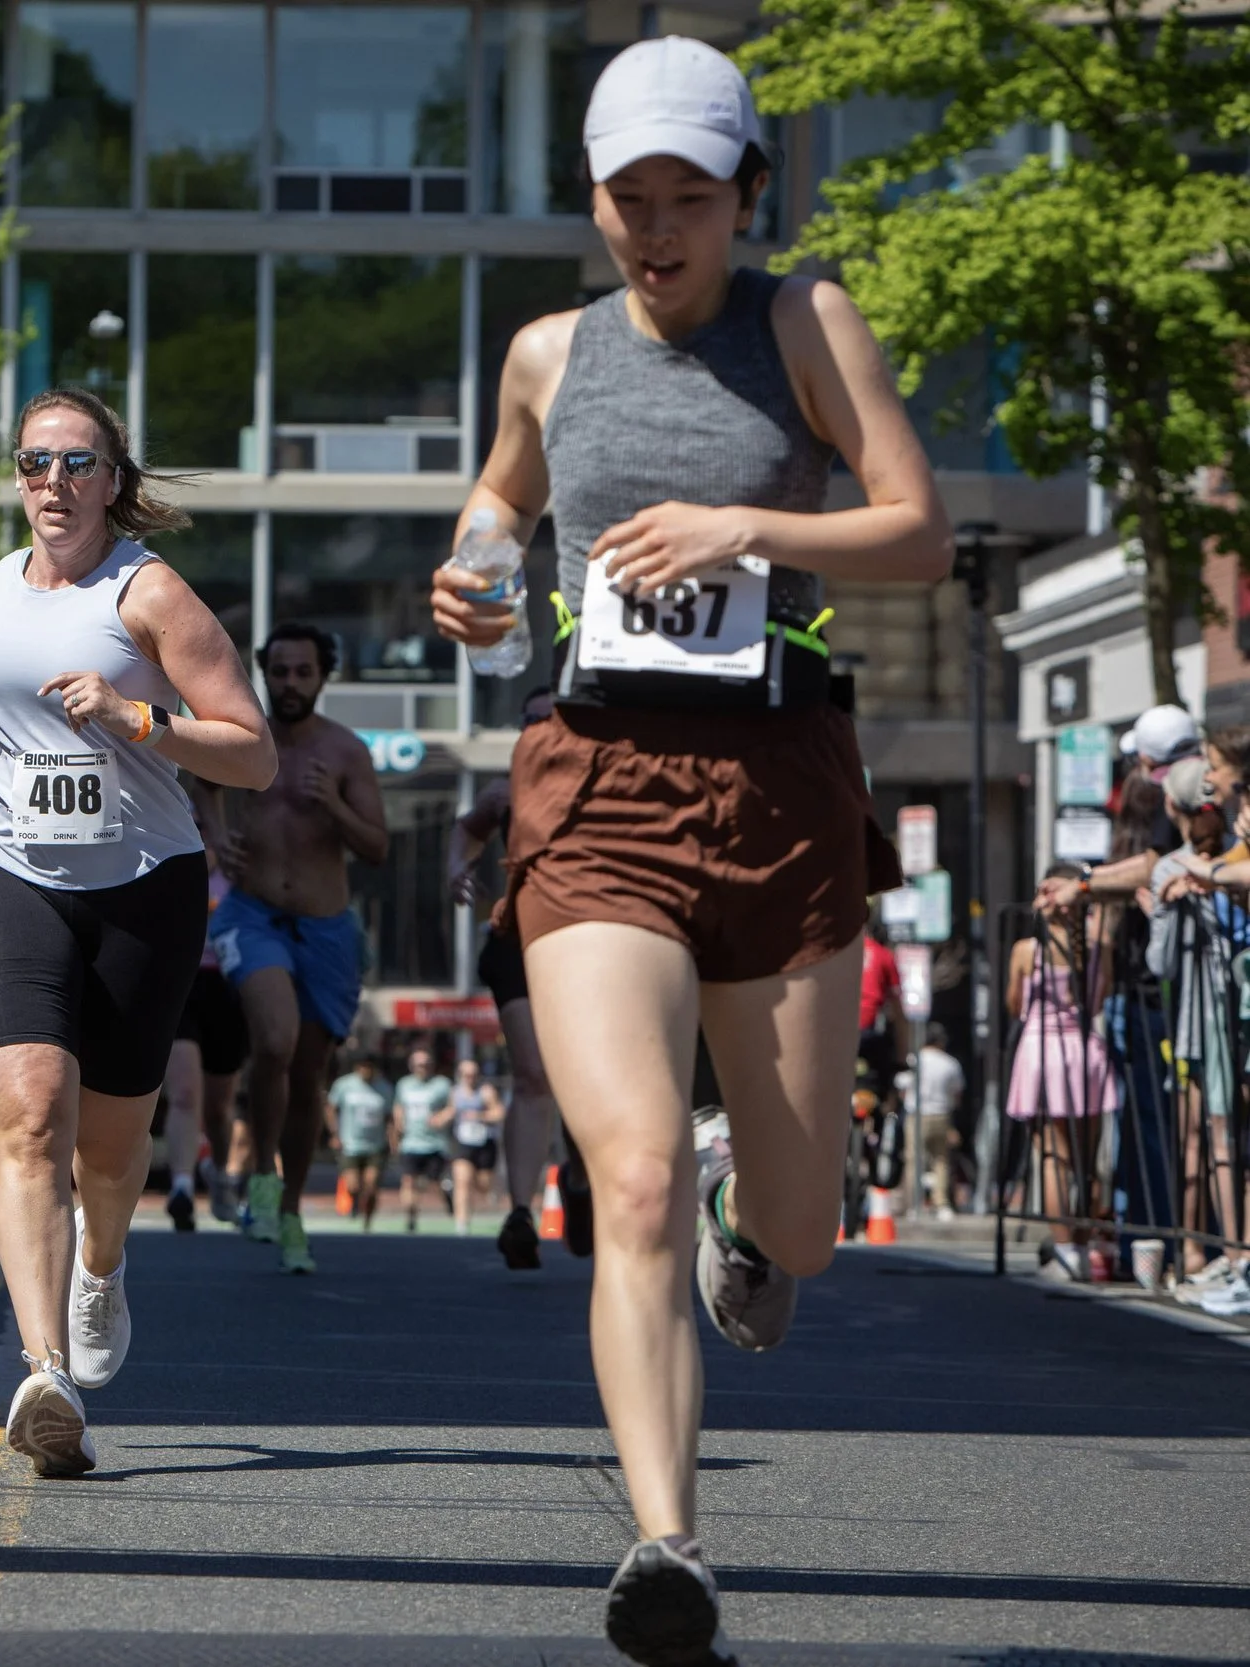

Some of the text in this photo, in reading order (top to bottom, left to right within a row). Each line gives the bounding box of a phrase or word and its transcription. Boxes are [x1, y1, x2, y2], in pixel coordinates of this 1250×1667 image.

[24, 753, 95, 767] BIONIC
[29, 774, 102, 816] 408
[93, 831, 116, 839] DRINK
